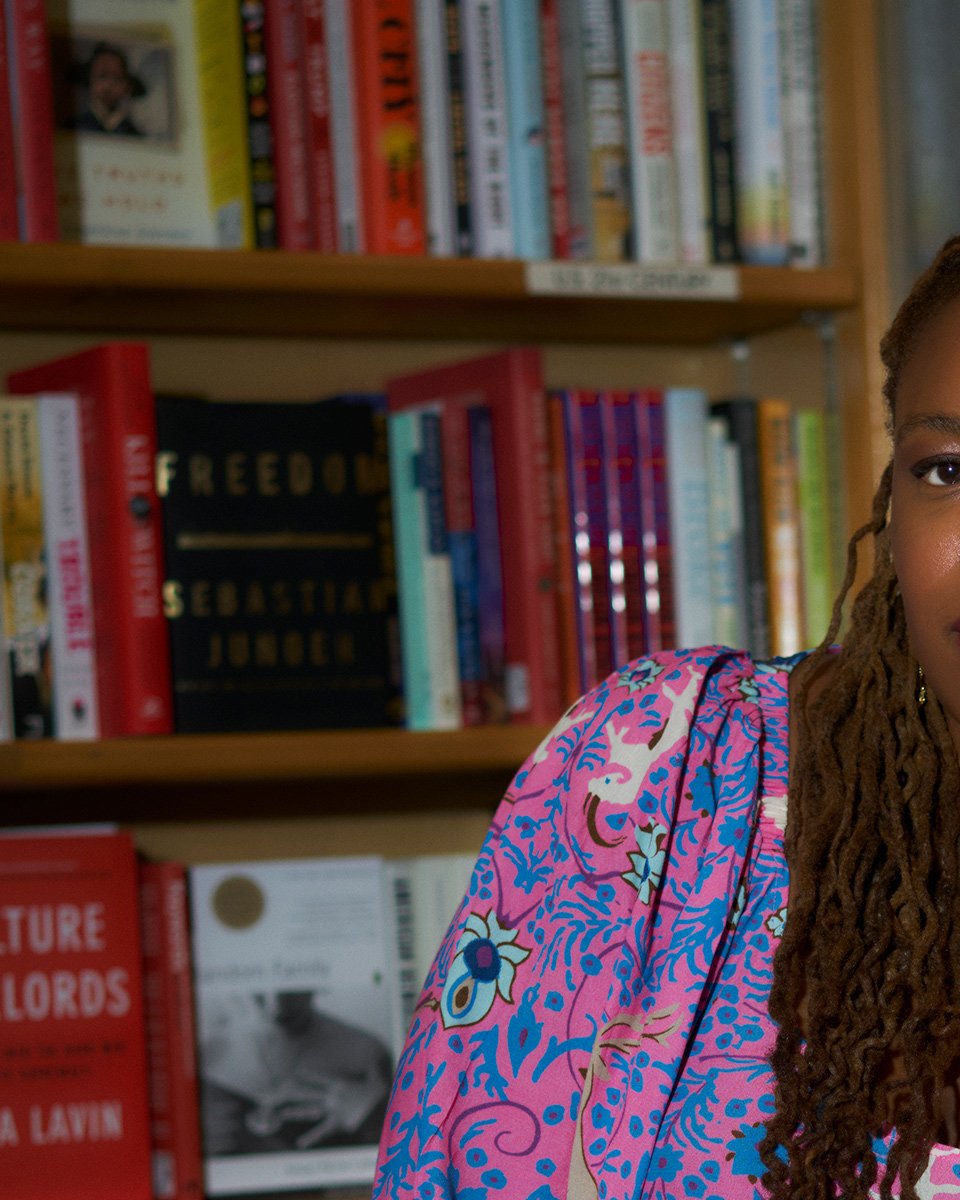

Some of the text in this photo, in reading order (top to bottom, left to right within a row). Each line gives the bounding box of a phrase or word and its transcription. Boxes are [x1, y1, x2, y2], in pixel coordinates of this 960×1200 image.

[0, 901, 108, 956] TURE
[0, 965, 133, 1023] LORDS
[29, 1099, 124, 1147] LAVIN
